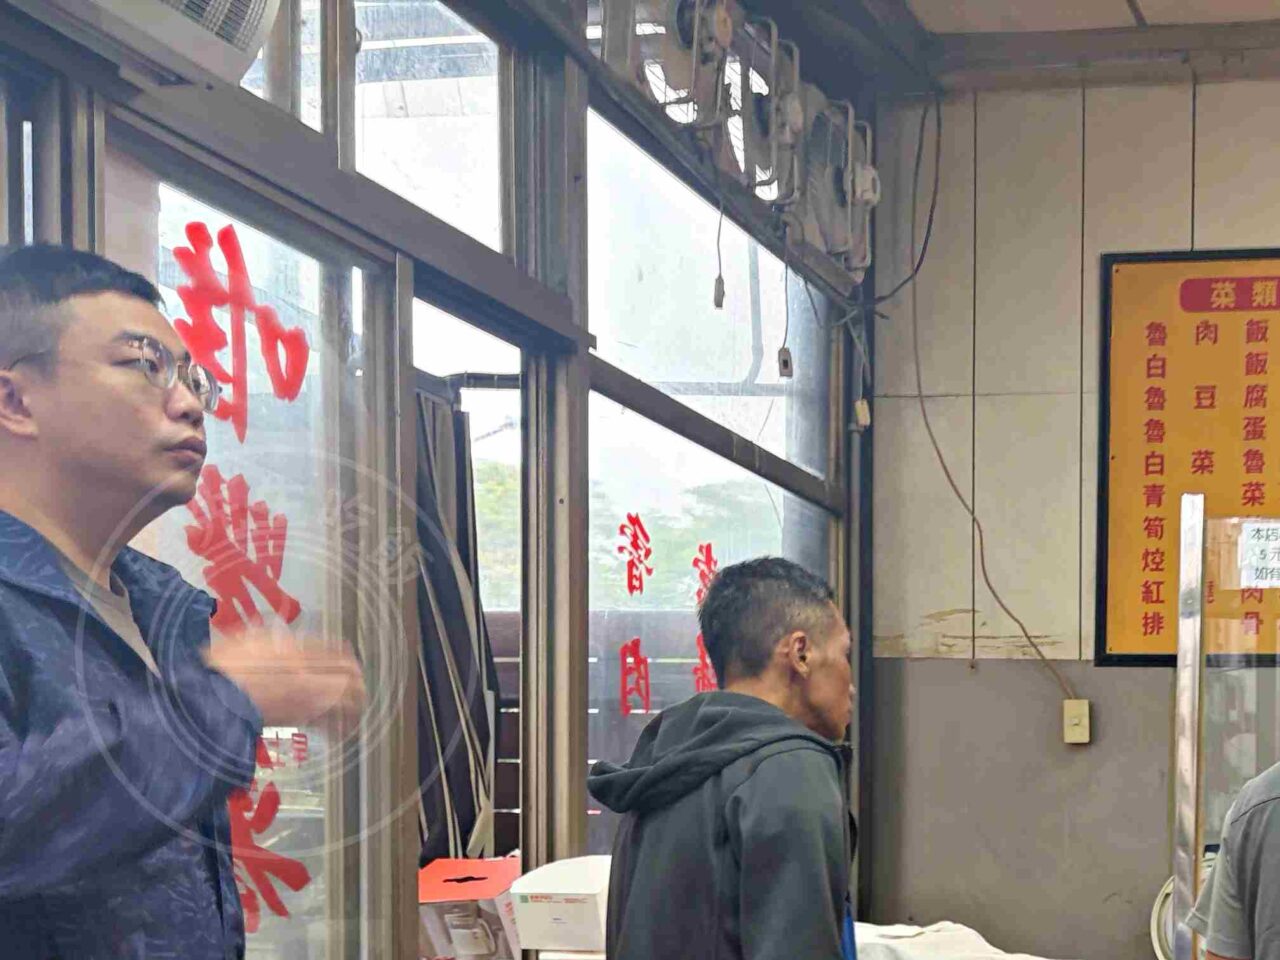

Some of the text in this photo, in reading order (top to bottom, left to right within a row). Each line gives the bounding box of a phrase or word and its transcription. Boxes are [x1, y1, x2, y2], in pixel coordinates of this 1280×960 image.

[1210, 281, 1277, 308] 菜類
[1145, 318, 1269, 347] 魯肉飯
[1146, 351, 1269, 379] 白飯
[1144, 384, 1267, 411] 魯豆腐
[1144, 416, 1266, 444] 魯蛋
[1144, 449, 1265, 476] 白菜魯
[1143, 481, 1265, 508] 青菜
